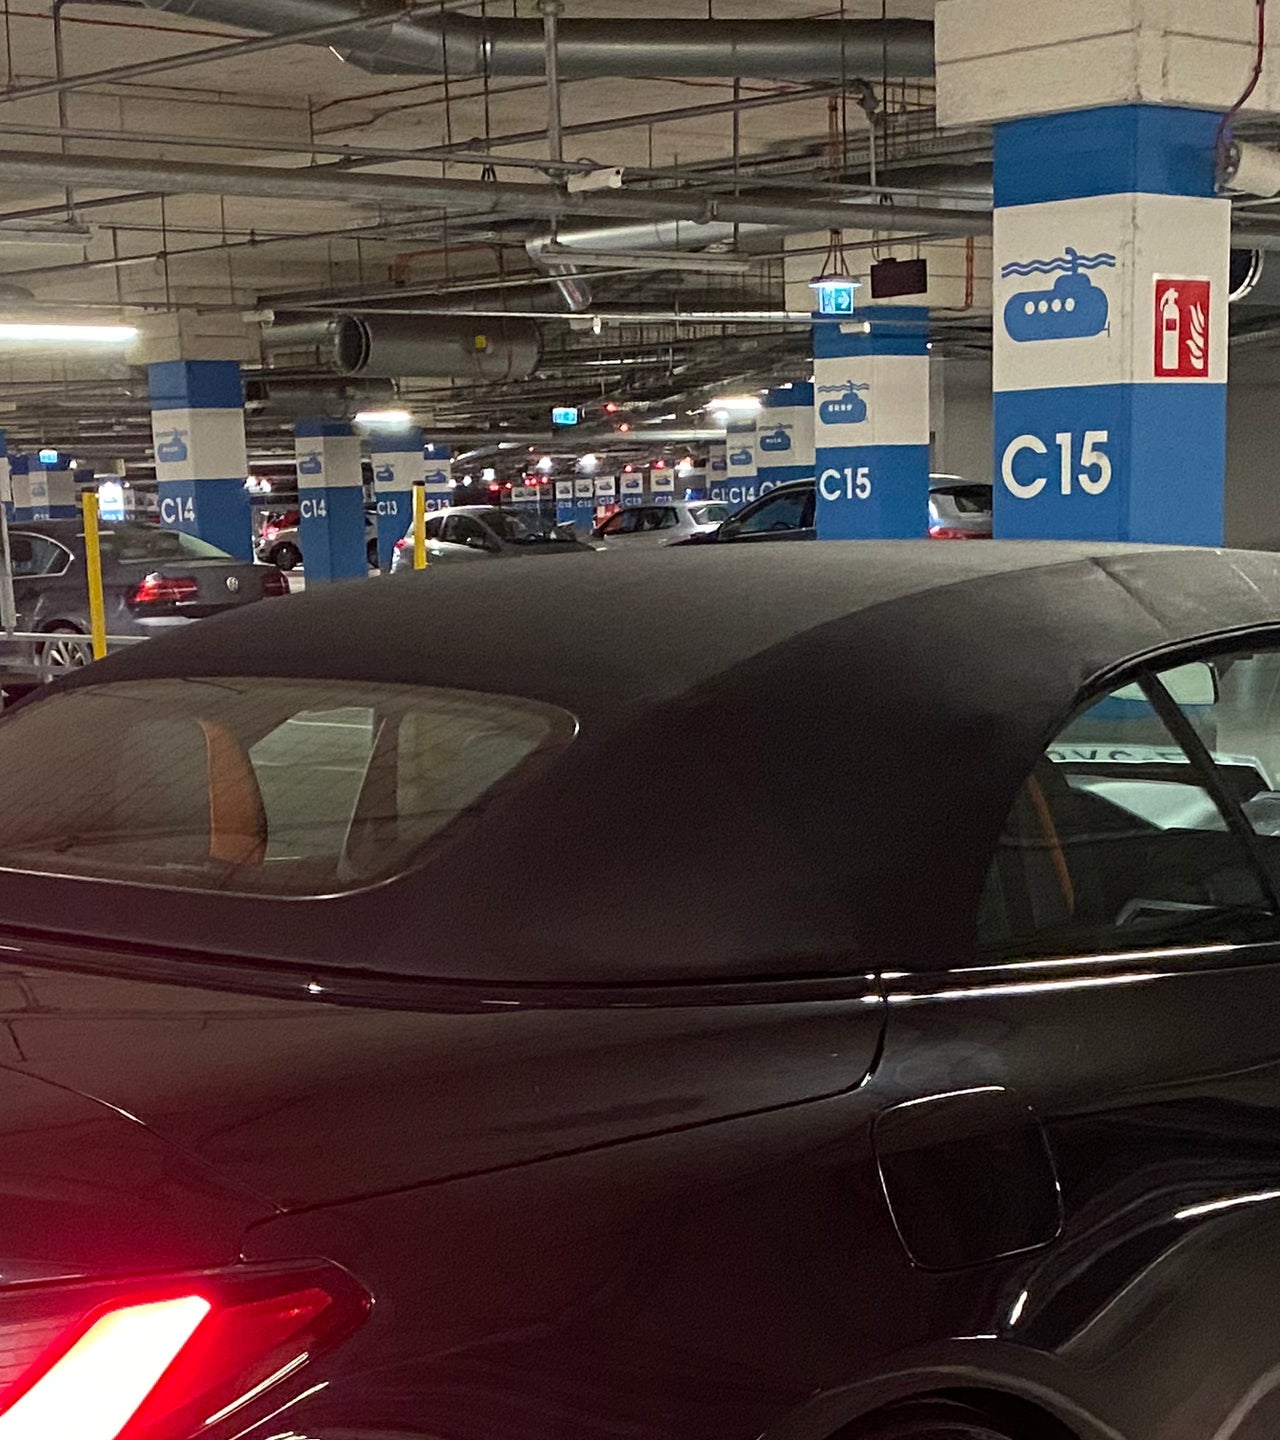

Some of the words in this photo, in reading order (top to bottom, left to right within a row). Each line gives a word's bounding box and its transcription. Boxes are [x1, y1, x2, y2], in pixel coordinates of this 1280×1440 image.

[1001, 430, 1112, 499] C15
[729, 486, 756, 504] C14
[819, 467, 871, 501] C15
[161, 496, 196, 524] C14
[300, 499, 328, 519] C14
[376, 500, 398, 516] C13
